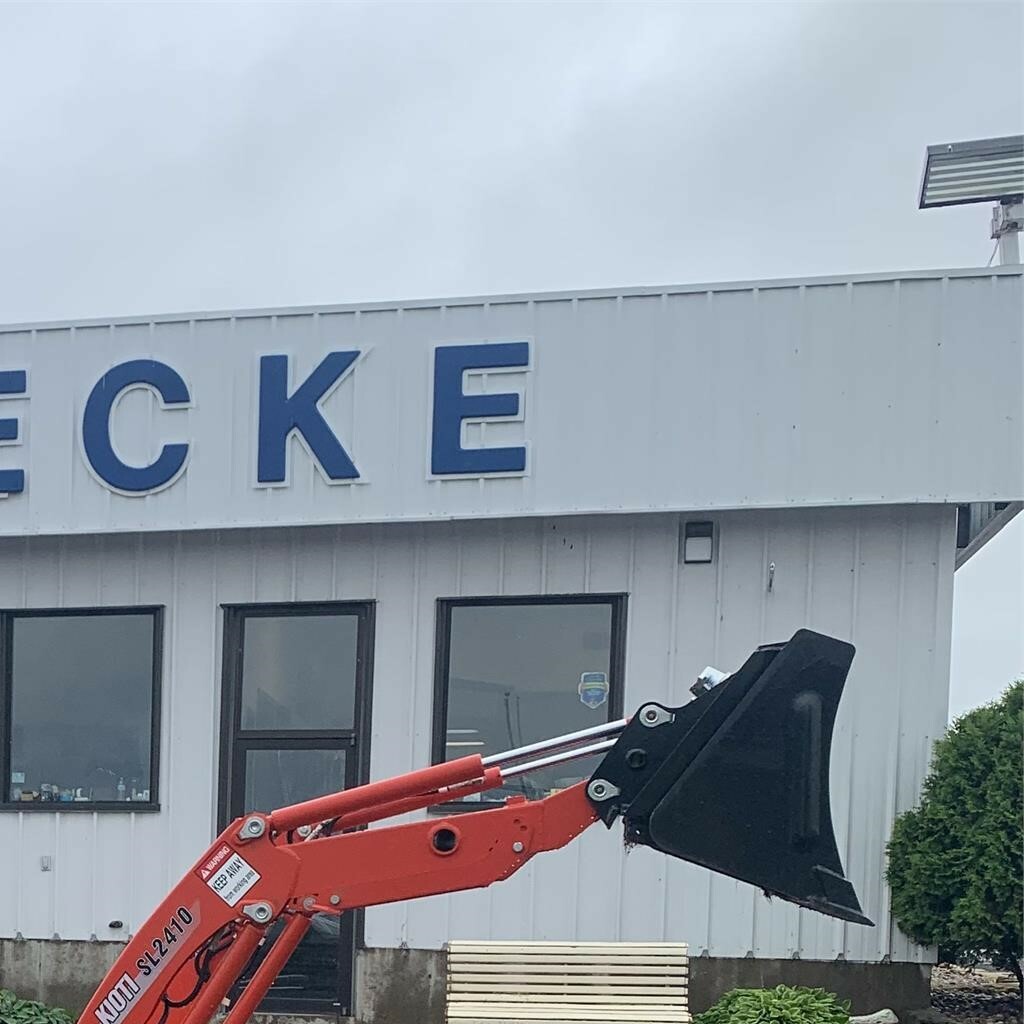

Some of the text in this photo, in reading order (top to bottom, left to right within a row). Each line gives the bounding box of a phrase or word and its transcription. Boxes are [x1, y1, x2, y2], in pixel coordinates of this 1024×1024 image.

[204, 845, 231, 871] WARNING
[211, 857, 245, 893] KEEP AWAY
[136, 906, 193, 976] SL2410
